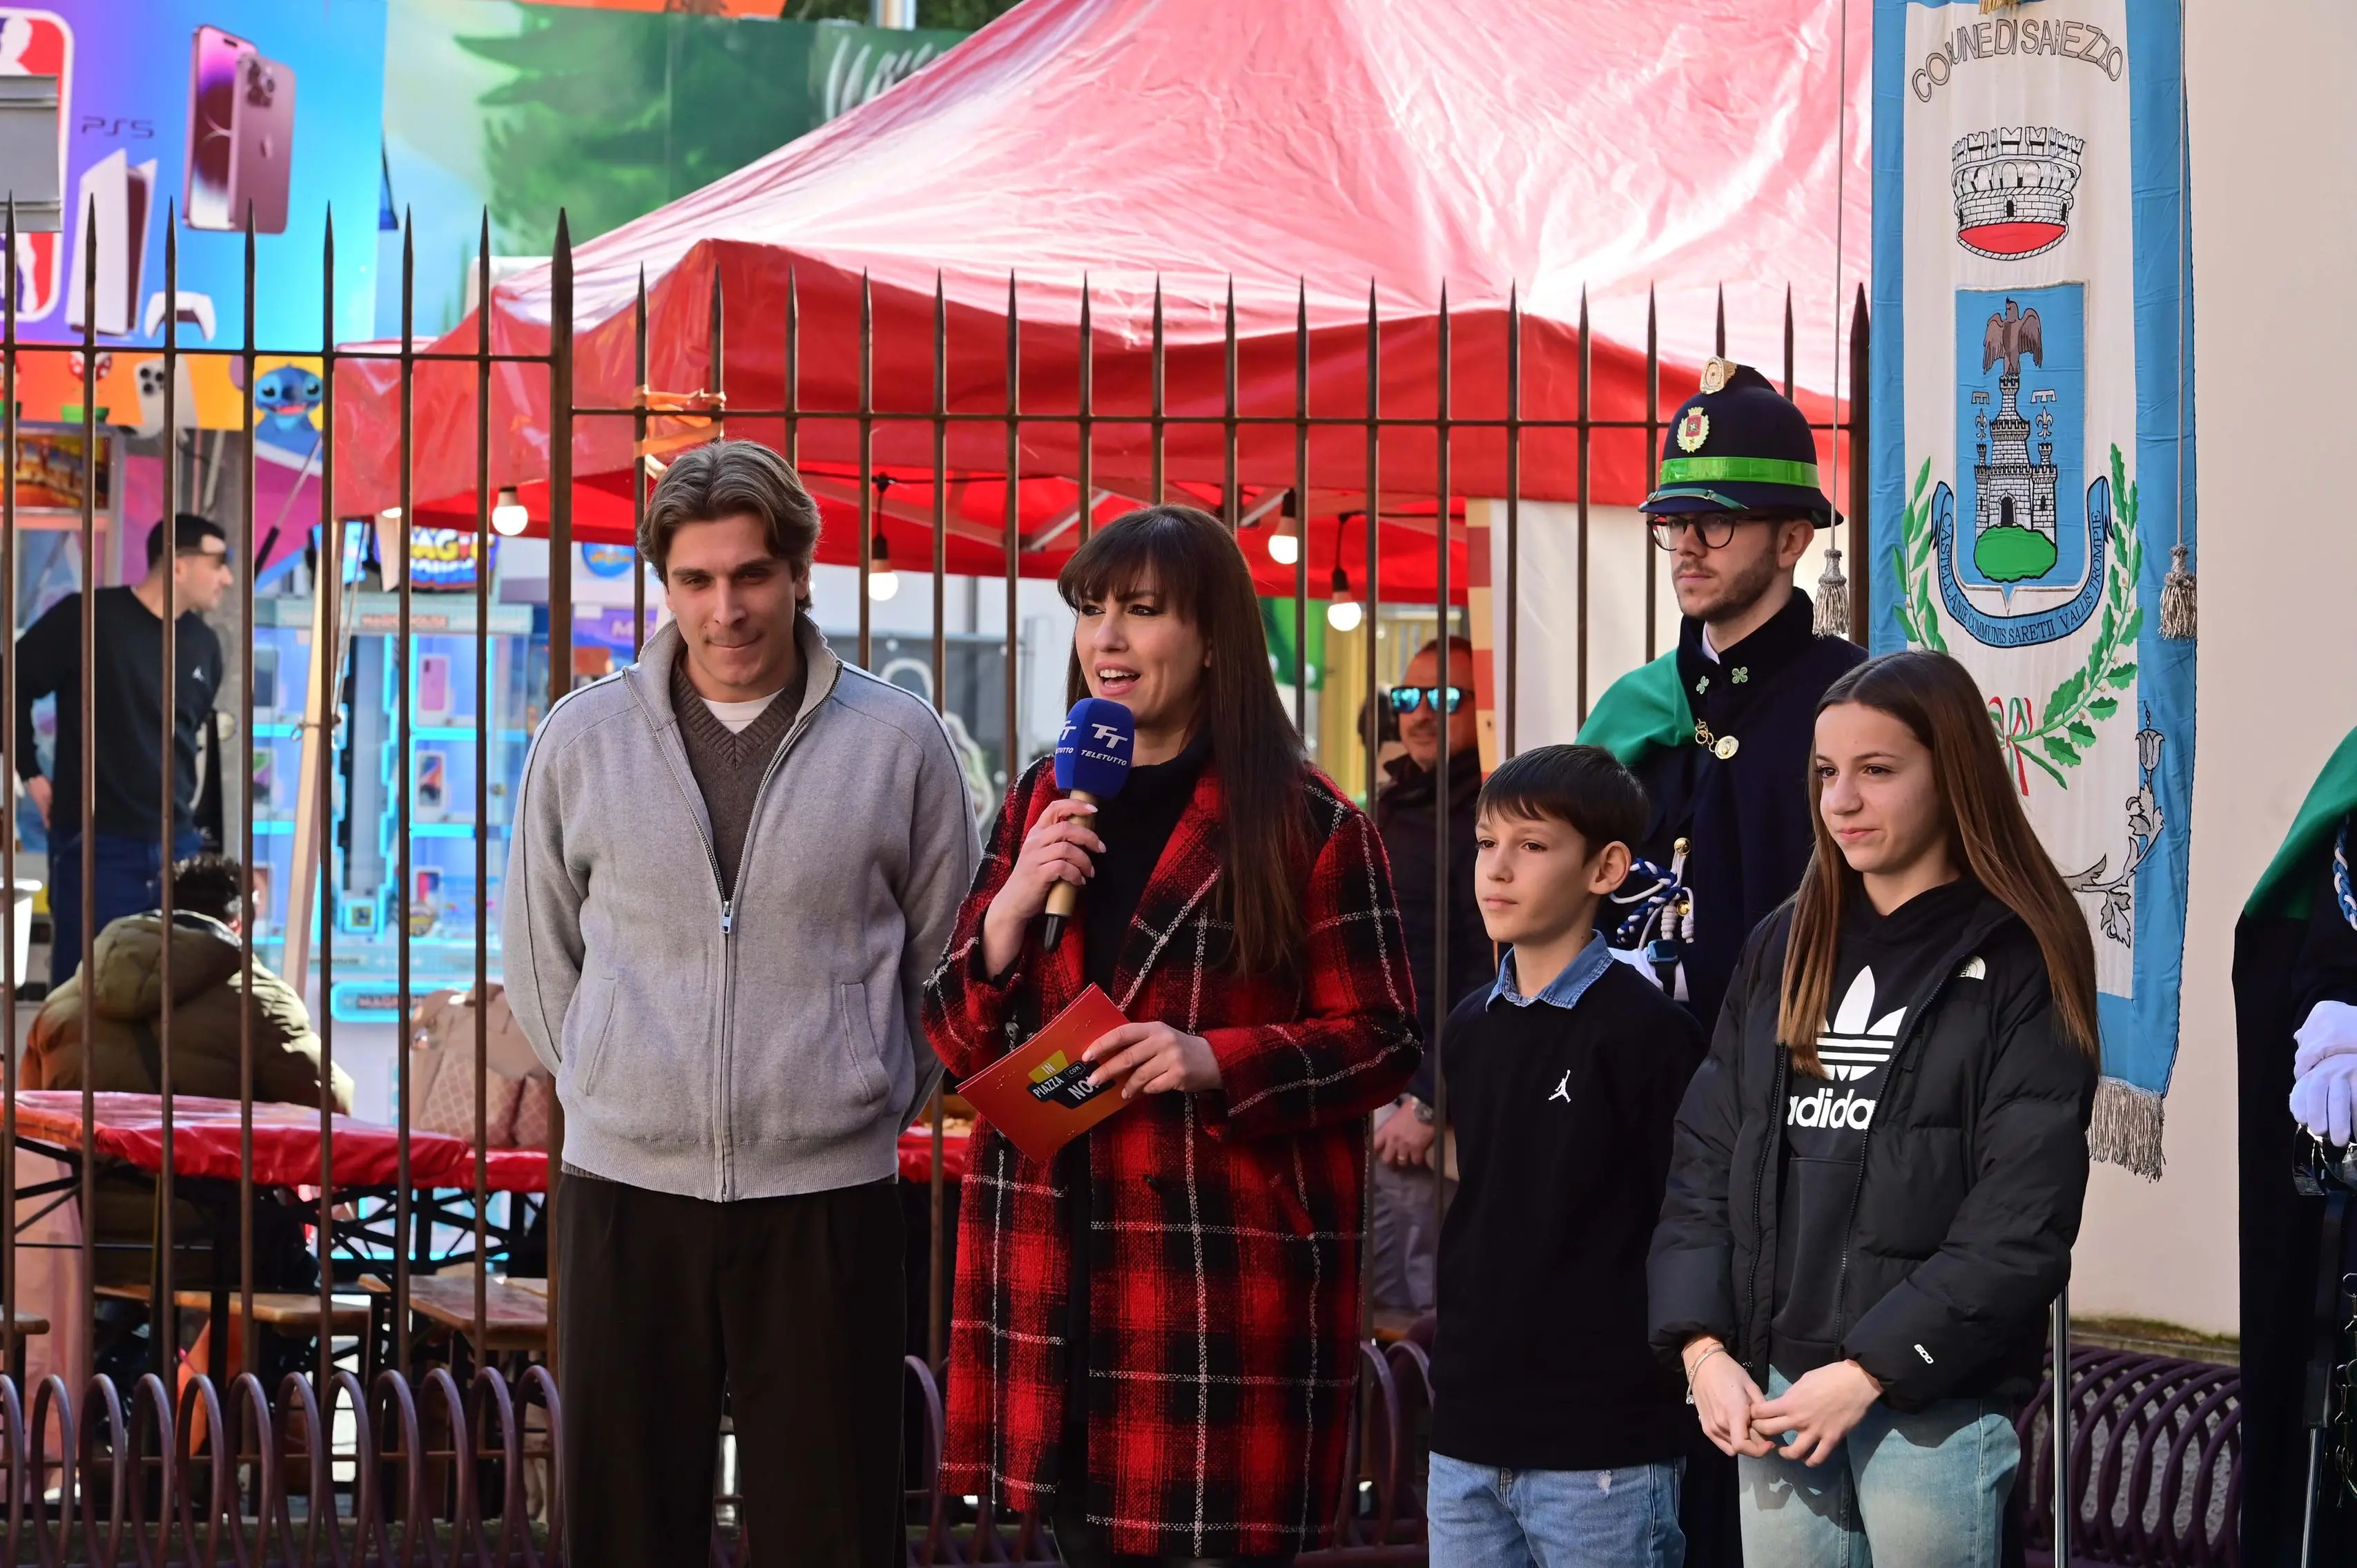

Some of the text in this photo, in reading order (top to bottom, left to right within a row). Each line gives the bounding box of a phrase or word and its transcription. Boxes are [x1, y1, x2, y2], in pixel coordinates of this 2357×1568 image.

[1994, 19, 2017, 55] DI
[2020, 19, 2124, 82] SAEZZO
[82, 115, 155, 139] PS5
[1968, 612, 2007, 644] COMMUNIS
[2059, 591, 2094, 631] VALLIS
[2089, 510, 2102, 592] TROMPIE
[1080, 749, 1127, 766] TELETUTTO
[1041, 1063, 1056, 1075] IN
[1069, 1065, 1081, 1075] con
[1032, 1076, 1065, 1098] PIAZZA
[1067, 1076, 1099, 1100] NO
[1914, 1344, 1934, 1364] 600
